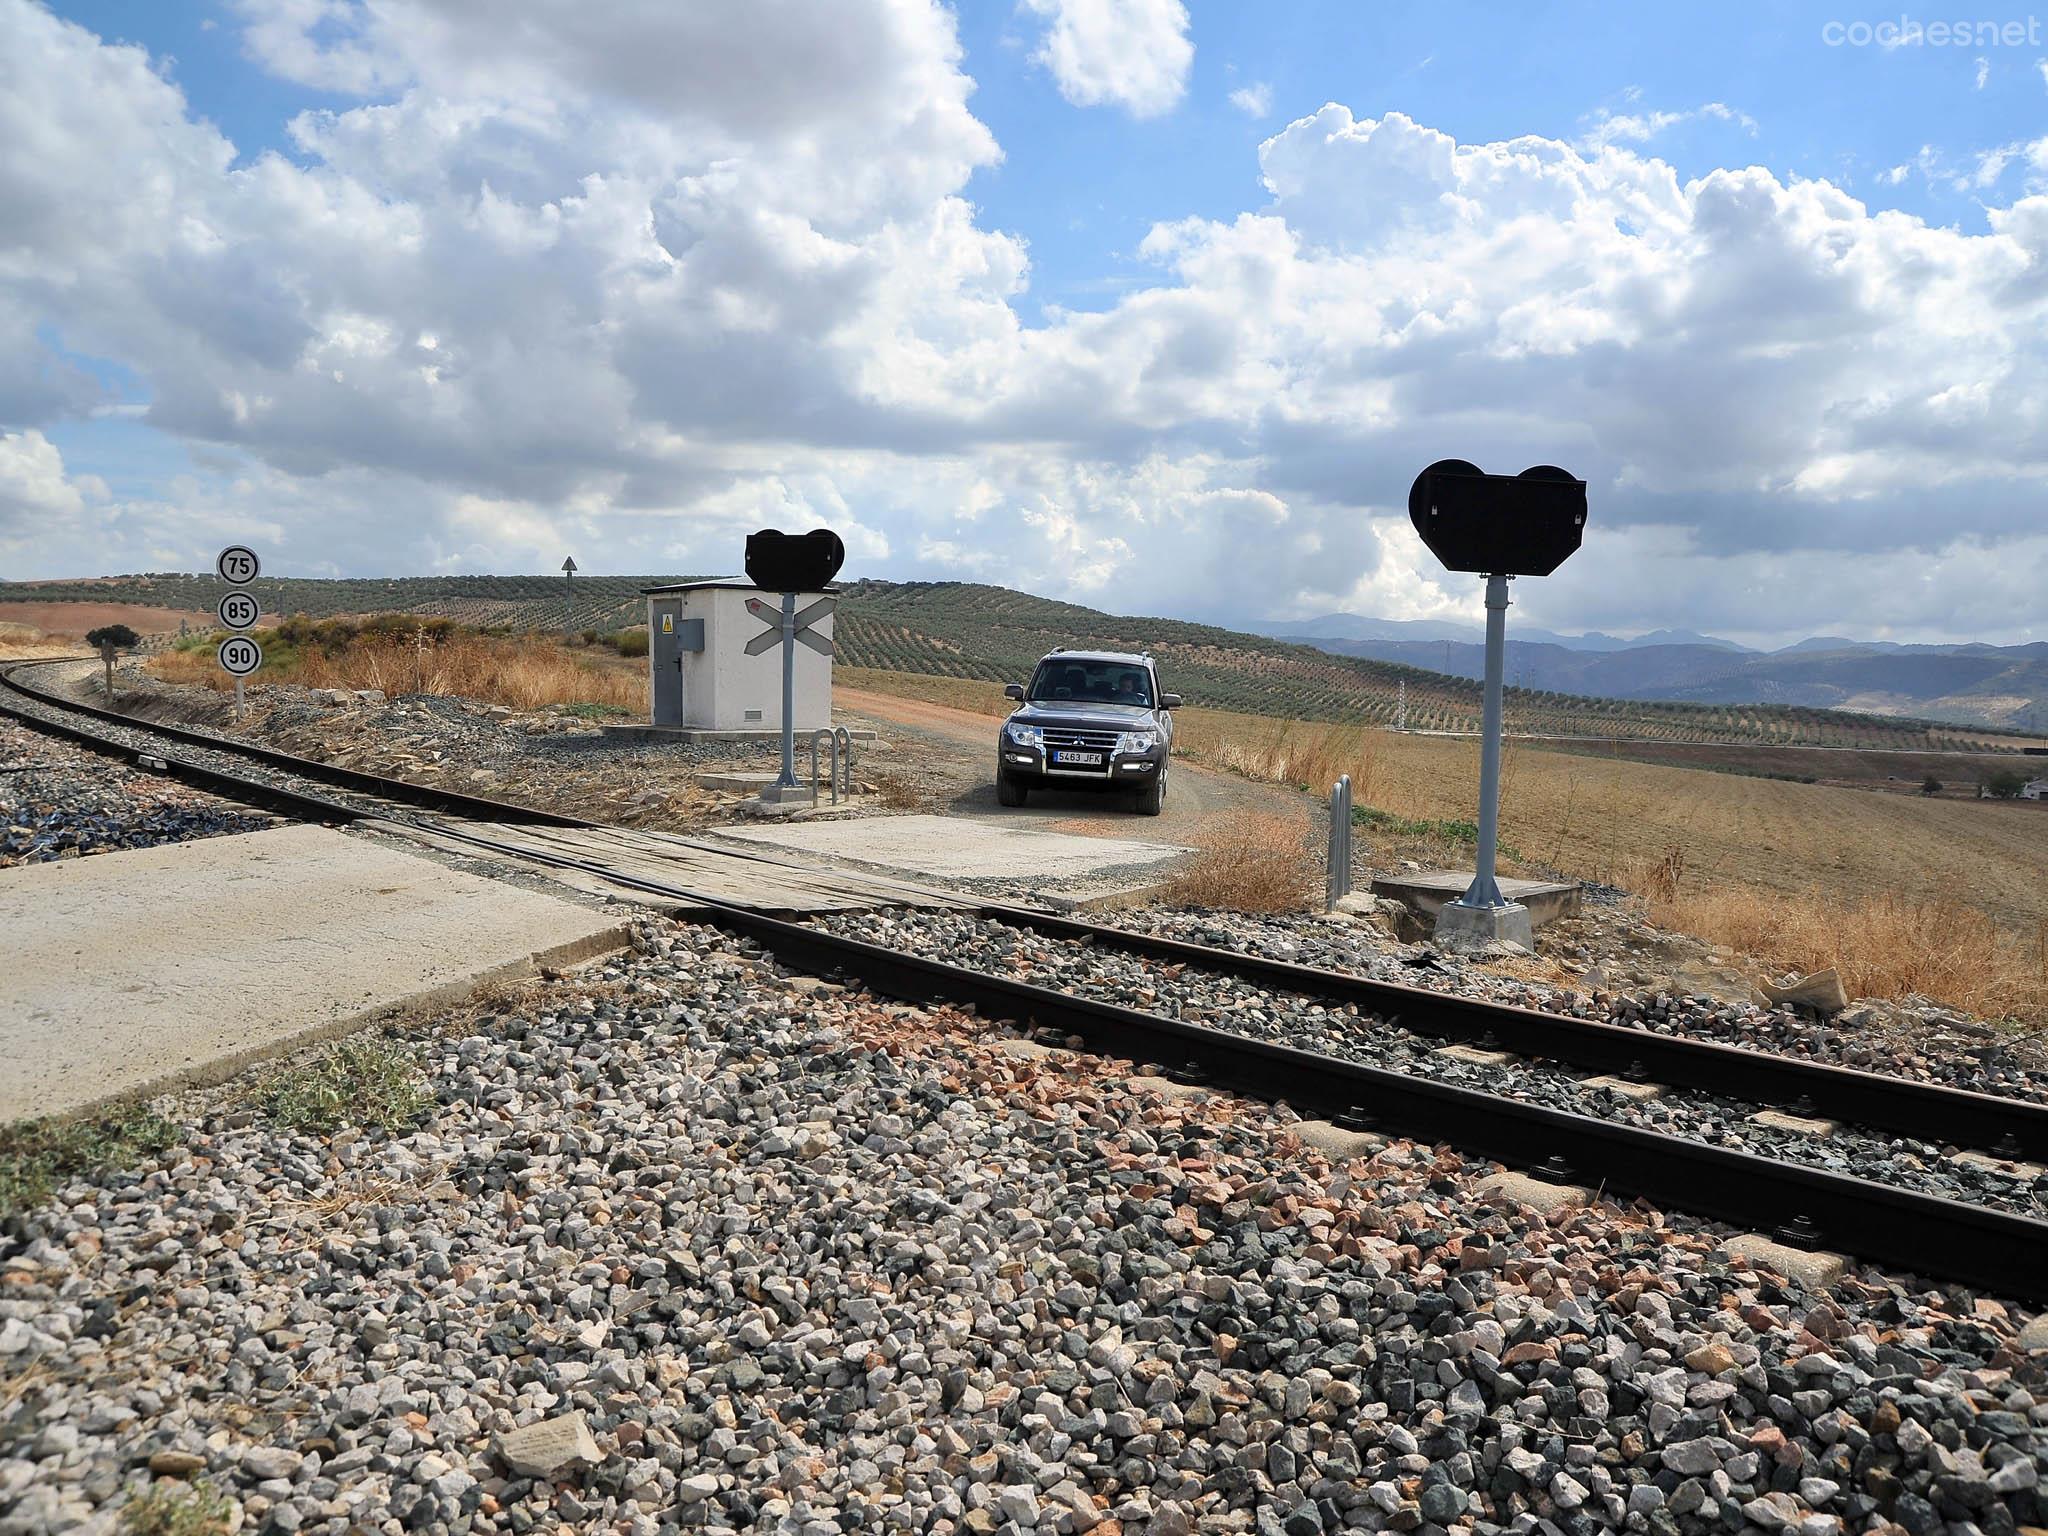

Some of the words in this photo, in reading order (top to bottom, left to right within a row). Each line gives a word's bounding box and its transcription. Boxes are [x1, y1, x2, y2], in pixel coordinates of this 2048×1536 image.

[228, 557, 250, 575] 75
[228, 601, 250, 619] 85
[228, 647, 251, 664] 90
[1059, 752, 1081, 762] 5463
[1083, 754, 1101, 763] JFK
